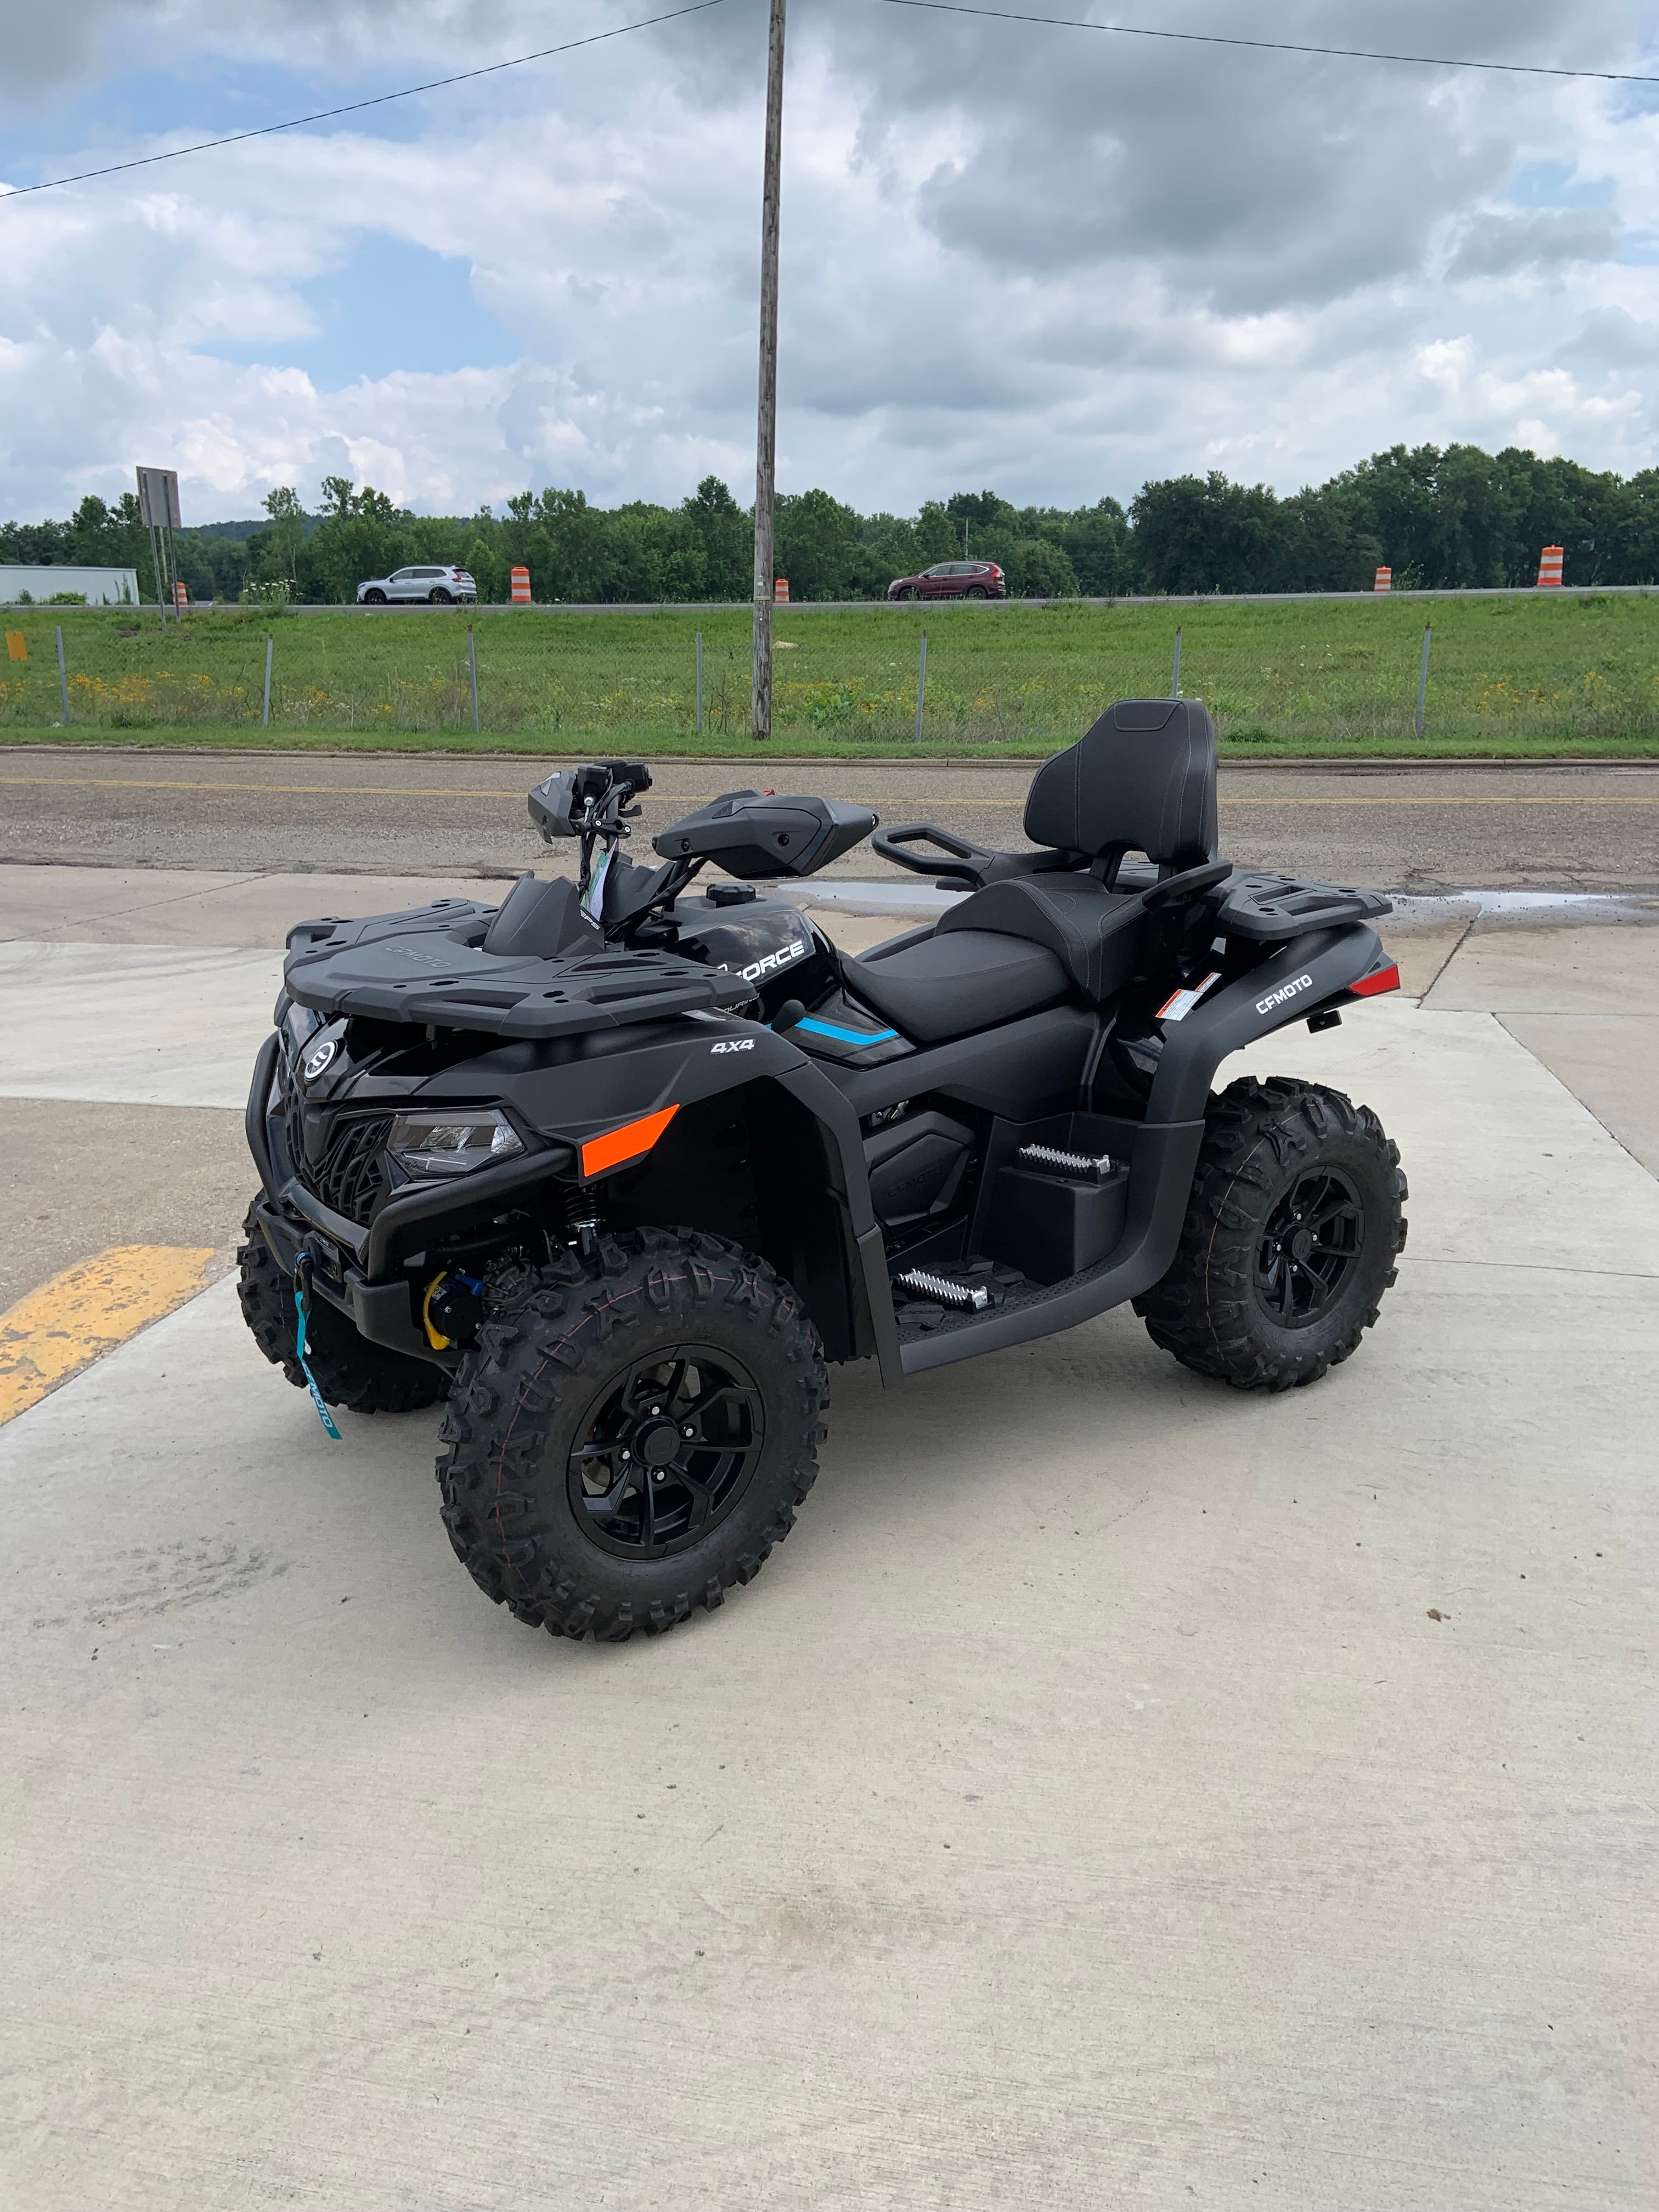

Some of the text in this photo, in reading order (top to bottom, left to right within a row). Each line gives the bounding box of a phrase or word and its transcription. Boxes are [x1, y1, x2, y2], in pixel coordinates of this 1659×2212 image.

[580, 909, 601, 930] EPS
[385, 945, 453, 968] CFMOTO
[1255, 974, 1313, 1014] CFMOTO
[302, 1362, 334, 1428] CFMOTO
